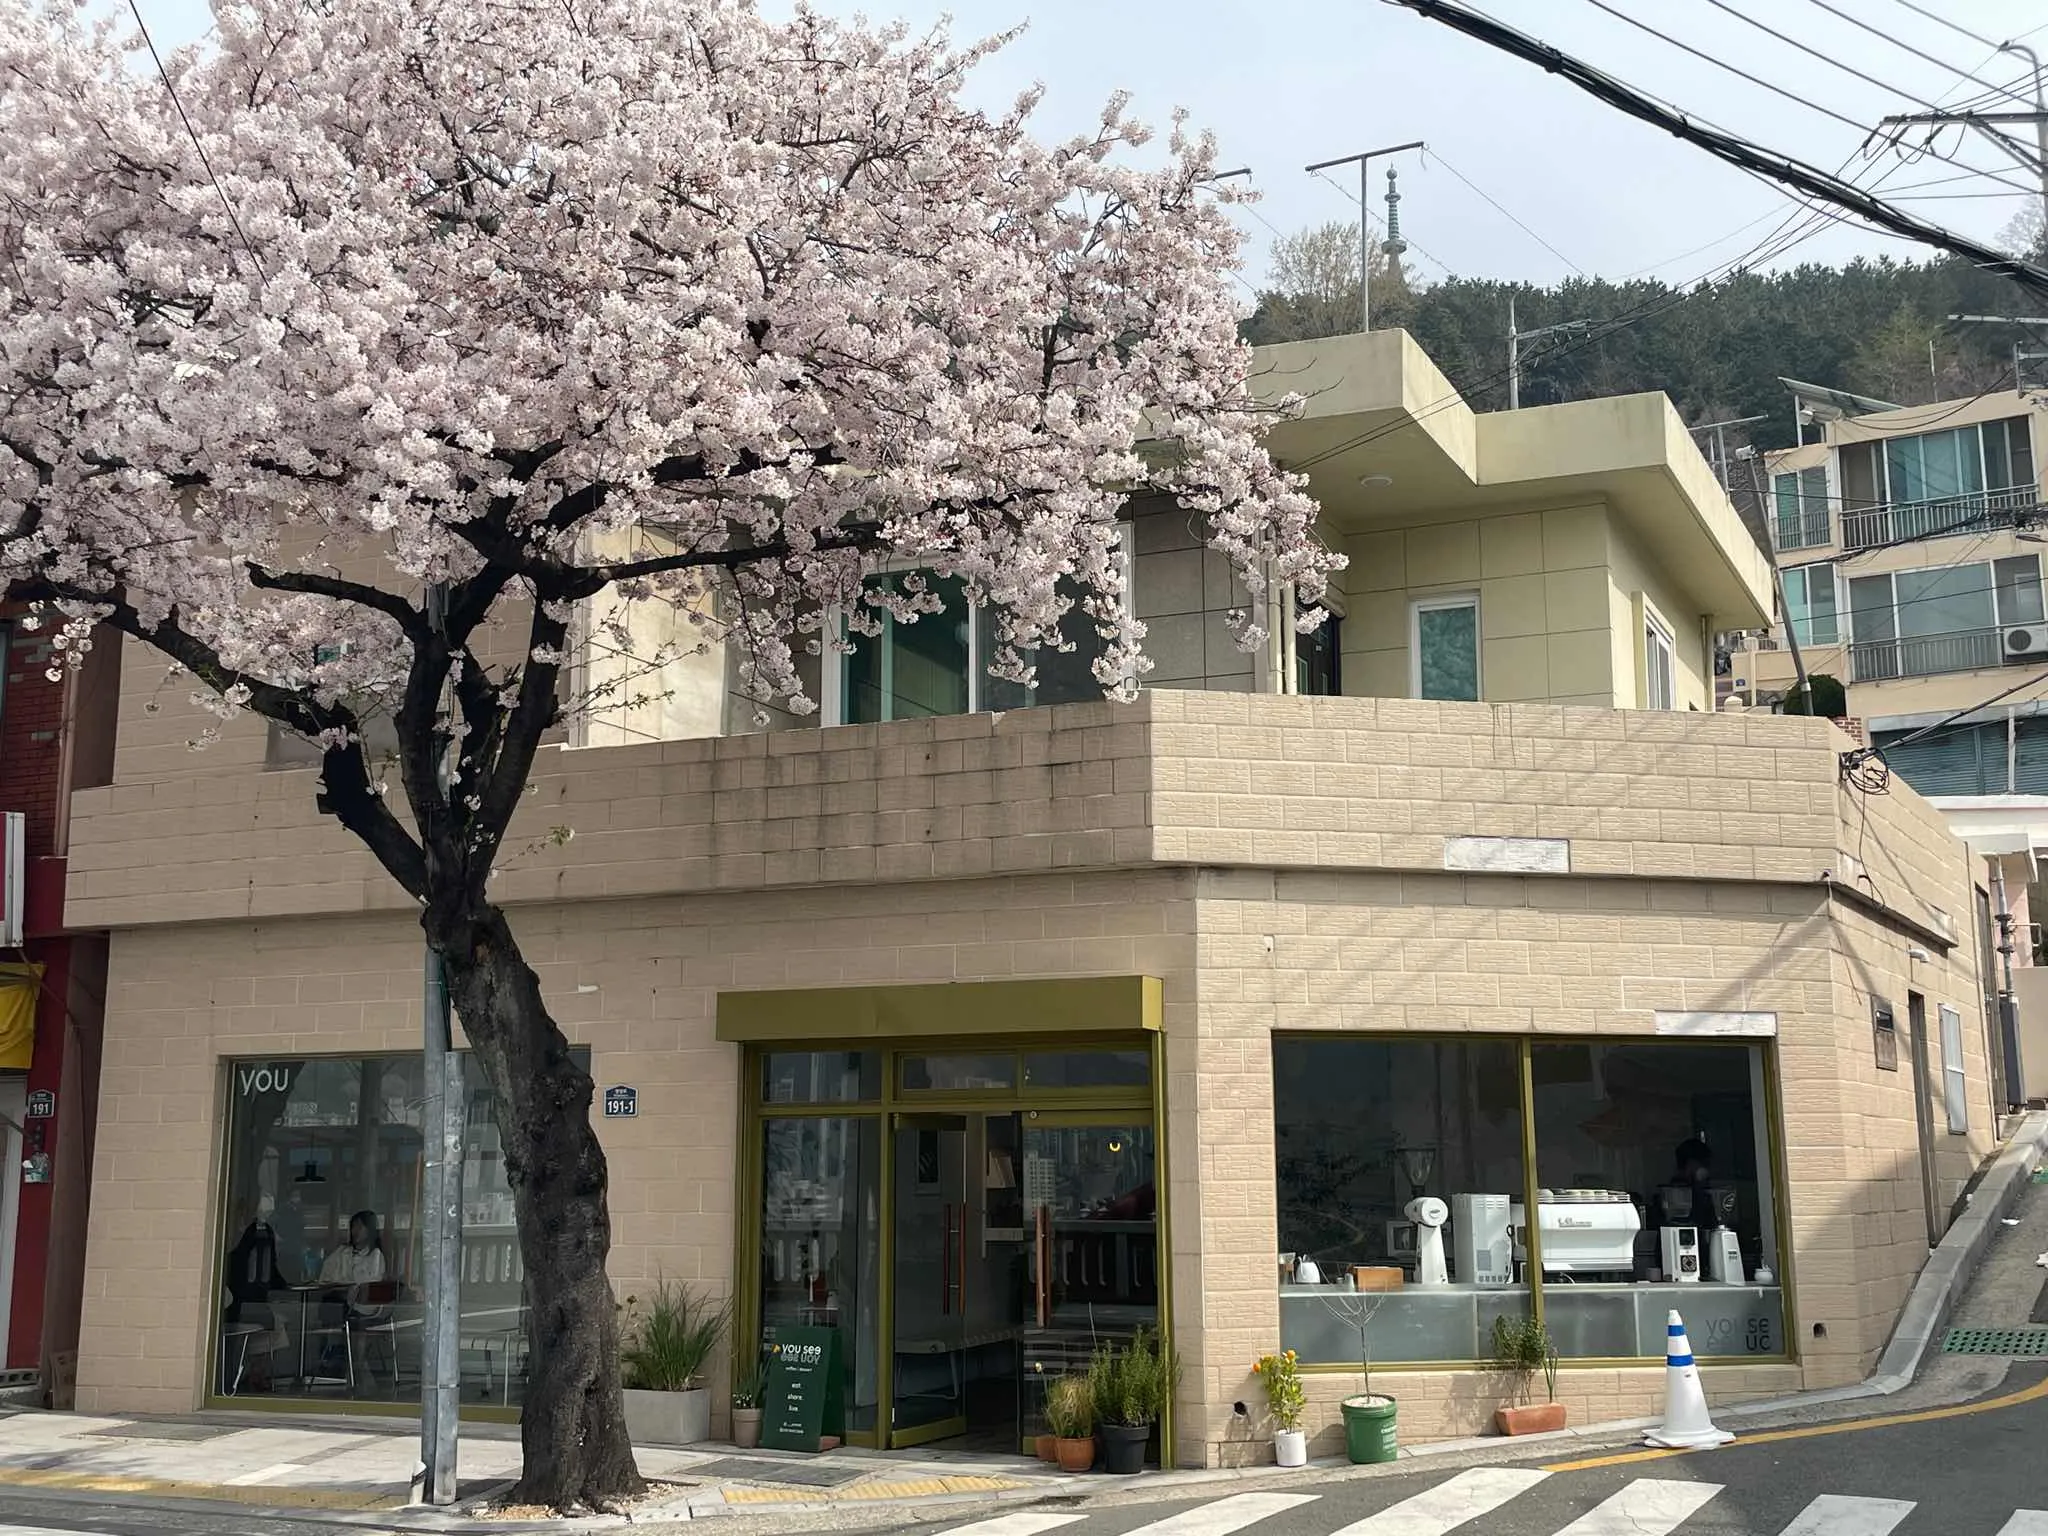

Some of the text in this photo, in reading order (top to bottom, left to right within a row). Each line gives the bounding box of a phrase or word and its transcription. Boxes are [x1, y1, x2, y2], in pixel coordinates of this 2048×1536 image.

[240, 1068, 289, 1096] you
[32, 1103, 49, 1115] 191
[607, 1100, 634, 1113] 191-1
[782, 1343, 801, 1354] you
